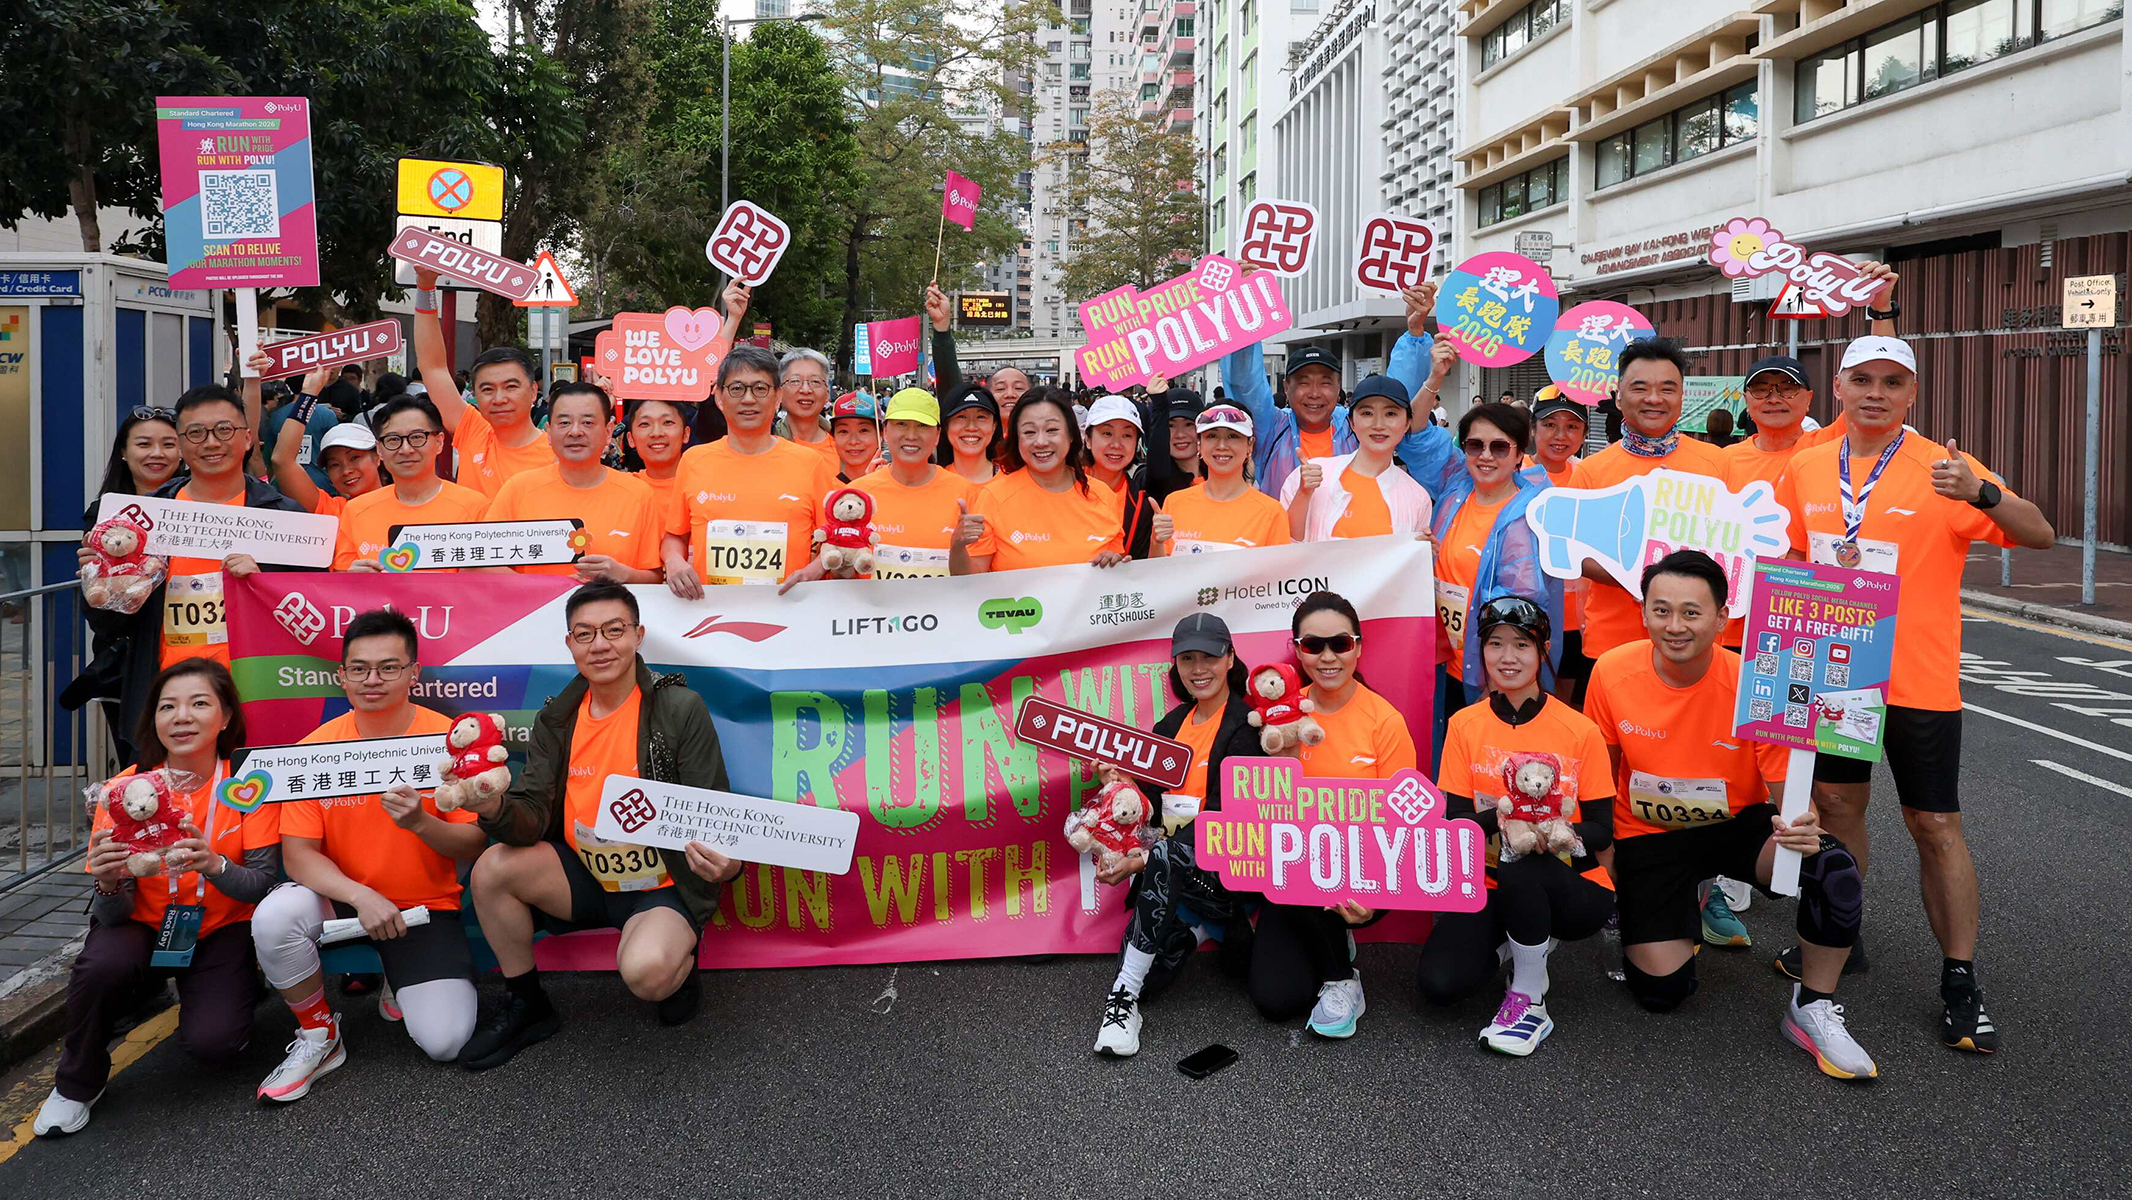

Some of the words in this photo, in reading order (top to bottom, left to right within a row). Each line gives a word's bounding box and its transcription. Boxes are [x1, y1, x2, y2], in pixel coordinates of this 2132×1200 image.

[278, 104, 301, 113] PolyU
[187, 121, 206, 129] Hong
[207, 121, 225, 129] Kong
[226, 120, 257, 128] Marathon
[217, 135, 250, 153] RUN
[251, 136, 271, 144] WITH
[252, 145, 274, 153] PRIDE
[197, 156, 216, 165] RUN
[218, 155, 242, 165] WITH
[244, 155, 275, 165] POLYU!
[203, 244, 230, 257] SCAN
[232, 244, 245, 256] TO
[247, 242, 282, 255] RELIVE
[1581, 246, 1623, 265] CAUSEWAY
[1625, 242, 1642, 255] BAY
[186, 258, 207, 269] YOUR
[209, 257, 256, 268] MARATHON
[257, 256, 302, 267] MOMENTS!
[418, 239, 512, 284] POLYU
[1596, 253, 1660, 275] ADVANCEMENT
[16, 285, 47, 293] Credit
[49, 285, 73, 293] Card
[148, 286, 172, 298] PCCW
[1479, 266, 1540, 314] 理大
[2069, 280, 2085, 288] Post
[2087, 279, 2111, 287] Office
[2094, 288, 2112, 297] only
[1087, 292, 1138, 330] RUN
[1113, 318, 1141, 336] WITH
[1138, 276, 1206, 323] PRIDE
[1455, 287, 1533, 345] 長跑隊
[625, 329, 660, 348] WE
[1083, 337, 1131, 376] RUN
[1108, 362, 1136, 382] WITH
[1127, 276, 1283, 377] POLYU!
[1449, 315, 1504, 358] 2026
[1576, 314, 1635, 346] 理大
[282, 330, 370, 369] POLYU
[893, 338, 919, 354] PolyU
[623, 348, 682, 367] LOVE
[623, 365, 699, 385] POLYU
[1567, 366, 1619, 398] 2026
[708, 493, 736, 503] PolyU
[1654, 477, 1716, 515] RUN
[1812, 503, 1837, 514] PolyU
[159, 508, 189, 522] THE
[192, 512, 234, 526] HONG
[236, 516, 274, 530] KONG
[157, 521, 252, 540] POLYTECHNIC
[254, 531, 328, 547] UNIVERSITY
[404, 533, 422, 542] The
[423, 532, 447, 543] Hong
[449, 531, 472, 542] Kong
[474, 528, 525, 541] Polytechnic
[526, 527, 568, 539] University
[877, 524, 905, 535] PolyU
[1024, 532, 1050, 543] PolyU
[1649, 508, 1742, 552] POLYU
[155, 534, 234, 551] 香港理工大學
[431, 545, 543, 563] 香港理工大學
[711, 546, 782, 570] T0324
[1757, 565, 1780, 575] Standard
[1781, 568, 1808, 577] Chartered
[1225, 583, 1272, 600] Hotel
[1279, 577, 1329, 596] ICON
[1770, 575, 1783, 583] Hong
[1785, 577, 1799, 586] Kong
[1800, 579, 1825, 589] Marathon
[1866, 580, 1891, 592] PolyU
[1100, 592, 1145, 610] 運動家
[1255, 602, 1280, 610] Owned
[1281, 602, 1290, 610] by
[1771, 589, 1792, 597] FOLLOW
[1793, 592, 1811, 600] POLYU
[1811, 594, 1830, 602] SOCIAL
[1831, 597, 1848, 605] MEDIA
[1849, 599, 1878, 610] CHANNELS
[985, 608, 1036, 619] TEVAU
[1090, 608, 1155, 626] SPORTSHOUSE
[1769, 596, 1805, 617] LIKE
[1809, 602, 1819, 618] 3
[1824, 604, 1876, 628] POSTS
[1767, 615, 1792, 630] GET
[1794, 619, 1802, 632] A
[1806, 621, 1837, 637] FREE
[1840, 626, 1874, 644] GIFT!
[1051, 714, 1159, 769] POLYU
[1635, 725, 1667, 740] PolyU
[1755, 729, 1768, 738] RUN
[1769, 731, 1786, 742] WITH
[1787, 734, 1805, 745] PRIDE
[1806, 737, 1820, 747] RUN
[1820, 740, 1837, 750] WITH
[1838, 742, 1860, 754] POLYU!
[770, 675, 1047, 834] RUN
[1059, 662, 1174, 728] WIT
[251, 758, 274, 769] The
[276, 755, 308, 770] Hong
[311, 753, 341, 766] Kong
[344, 747, 408, 764] Polytechnic
[286, 764, 432, 794] 香港理工大學
[570, 766, 596, 778] PolyU
[1232, 765, 1293, 801] RUN
[334, 796, 367, 808] PolyU
[663, 796, 694, 813] THE
[697, 801, 740, 820] HONG
[744, 808, 784, 825] KONG
[1298, 787, 1387, 824] PRIDE
[1258, 803, 1294, 821] WITH
[657, 824, 739, 848] 香港理工大學
[659, 811, 761, 835] POLYTECHNIC
[763, 825, 846, 849] UNIVERSITY
[1206, 821, 1267, 858] RUN
[581, 846, 658, 874] T0330
[1229, 859, 1266, 878] WITH
[1271, 823, 1477, 899] POLYU!
[857, 841, 1051, 930] WITH
[164, 910, 176, 929] Race
[158, 931, 170, 947] Day
